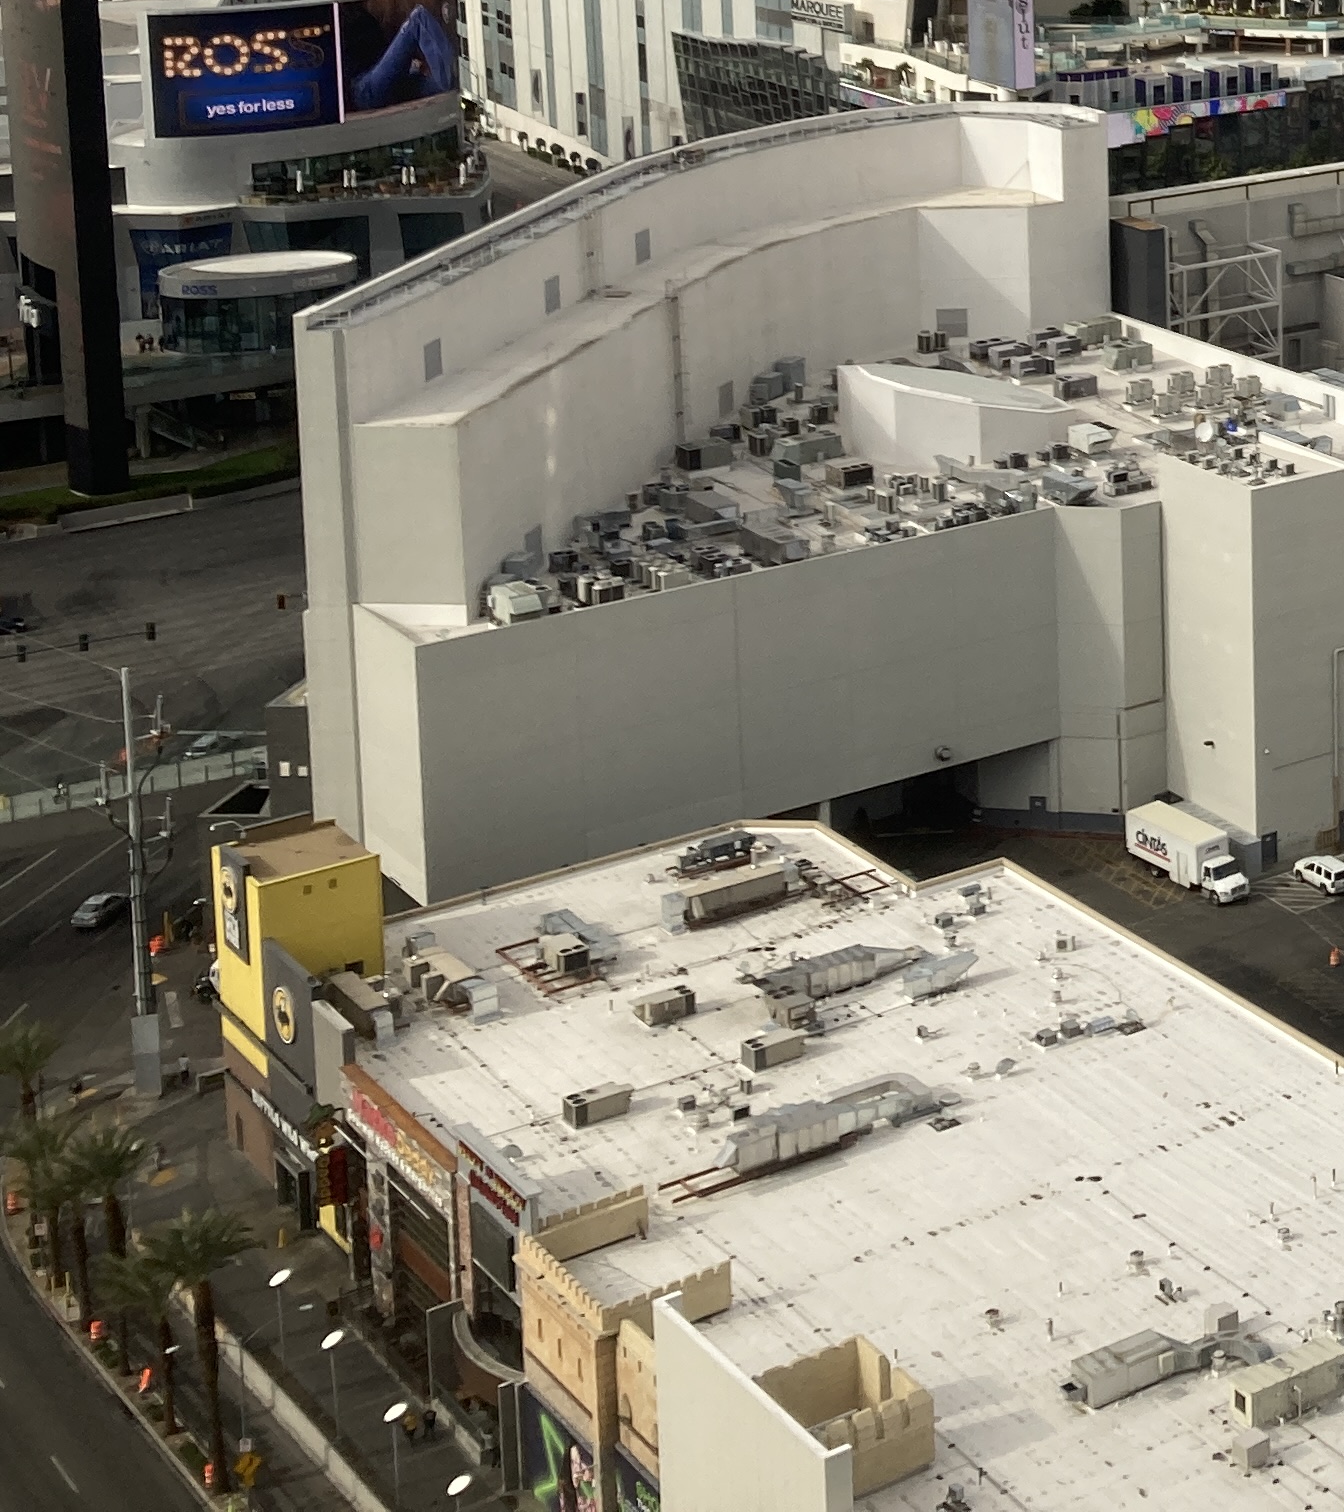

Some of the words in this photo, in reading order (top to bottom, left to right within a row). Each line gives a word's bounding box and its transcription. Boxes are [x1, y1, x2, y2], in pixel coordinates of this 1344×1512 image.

[163, 24, 331, 78] ROSS
[207, 102, 236, 118] yes
[238, 100, 261, 114] for
[262, 98, 295, 112] less
[181, 285, 218, 295] ROSS
